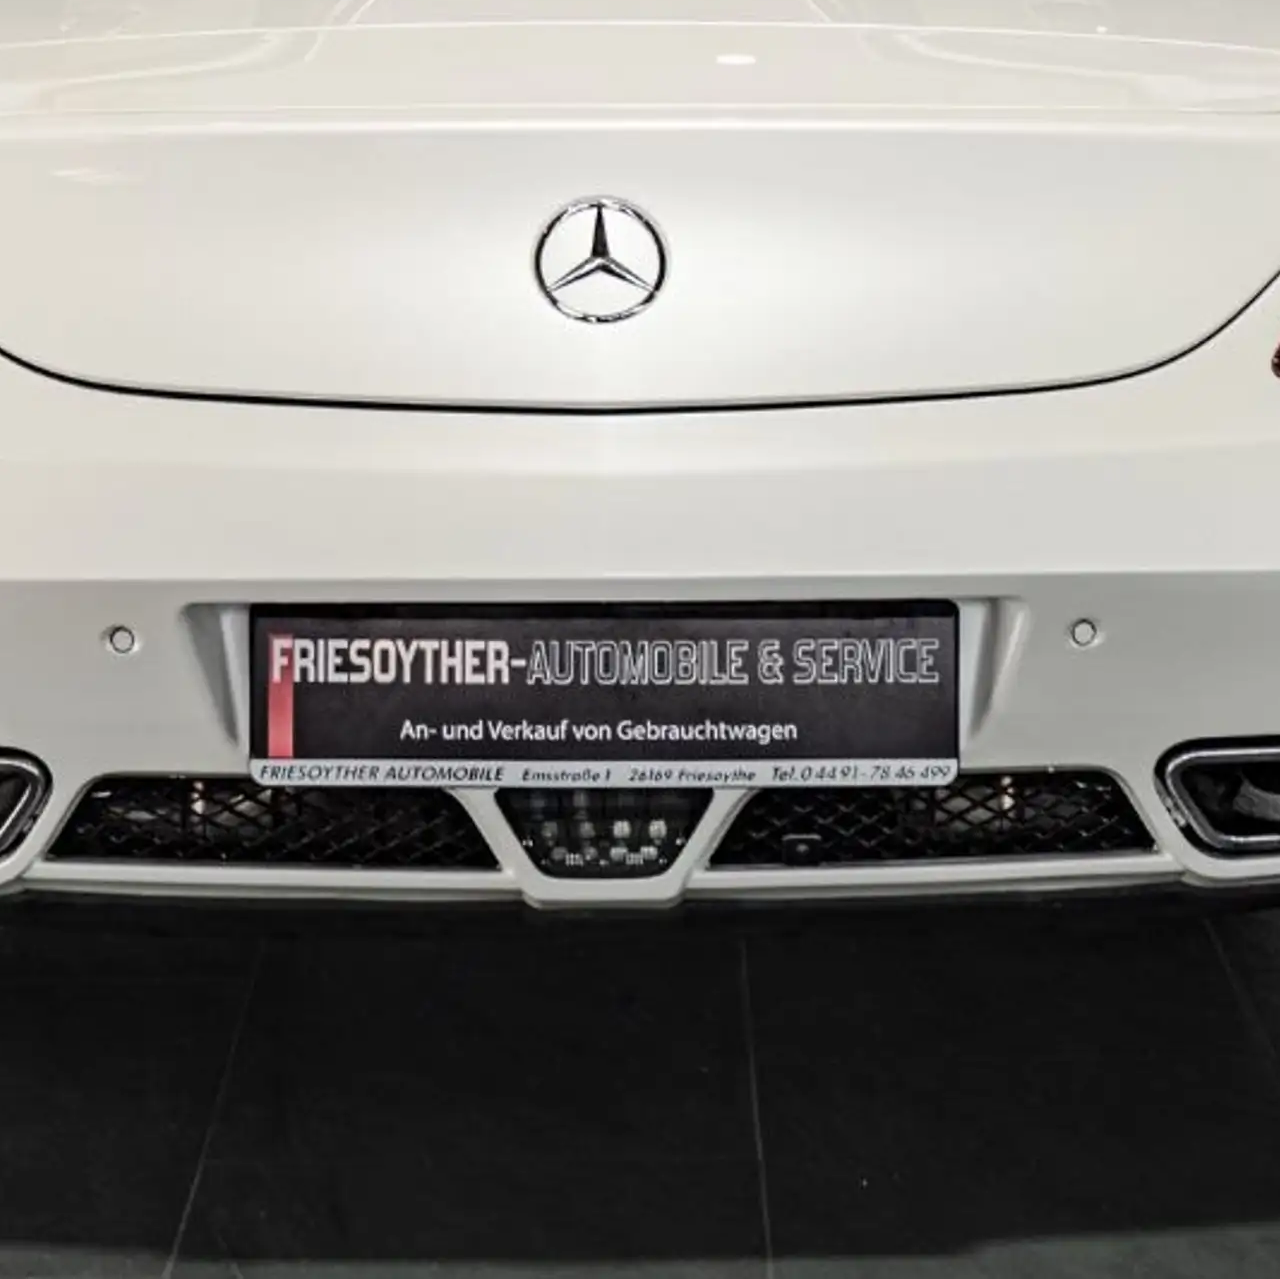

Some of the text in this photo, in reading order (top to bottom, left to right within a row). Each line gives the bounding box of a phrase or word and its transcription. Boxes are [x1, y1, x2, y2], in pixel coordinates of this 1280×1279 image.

[757, 638, 785, 685] &
[792, 638, 940, 684] SERVICE
[400, 719, 798, 745] An- und Verkauf von Gebrauchtwagen
[260, 765, 380, 782] FRIESOYTHER
[383, 765, 505, 782] AUTOMOBILE
